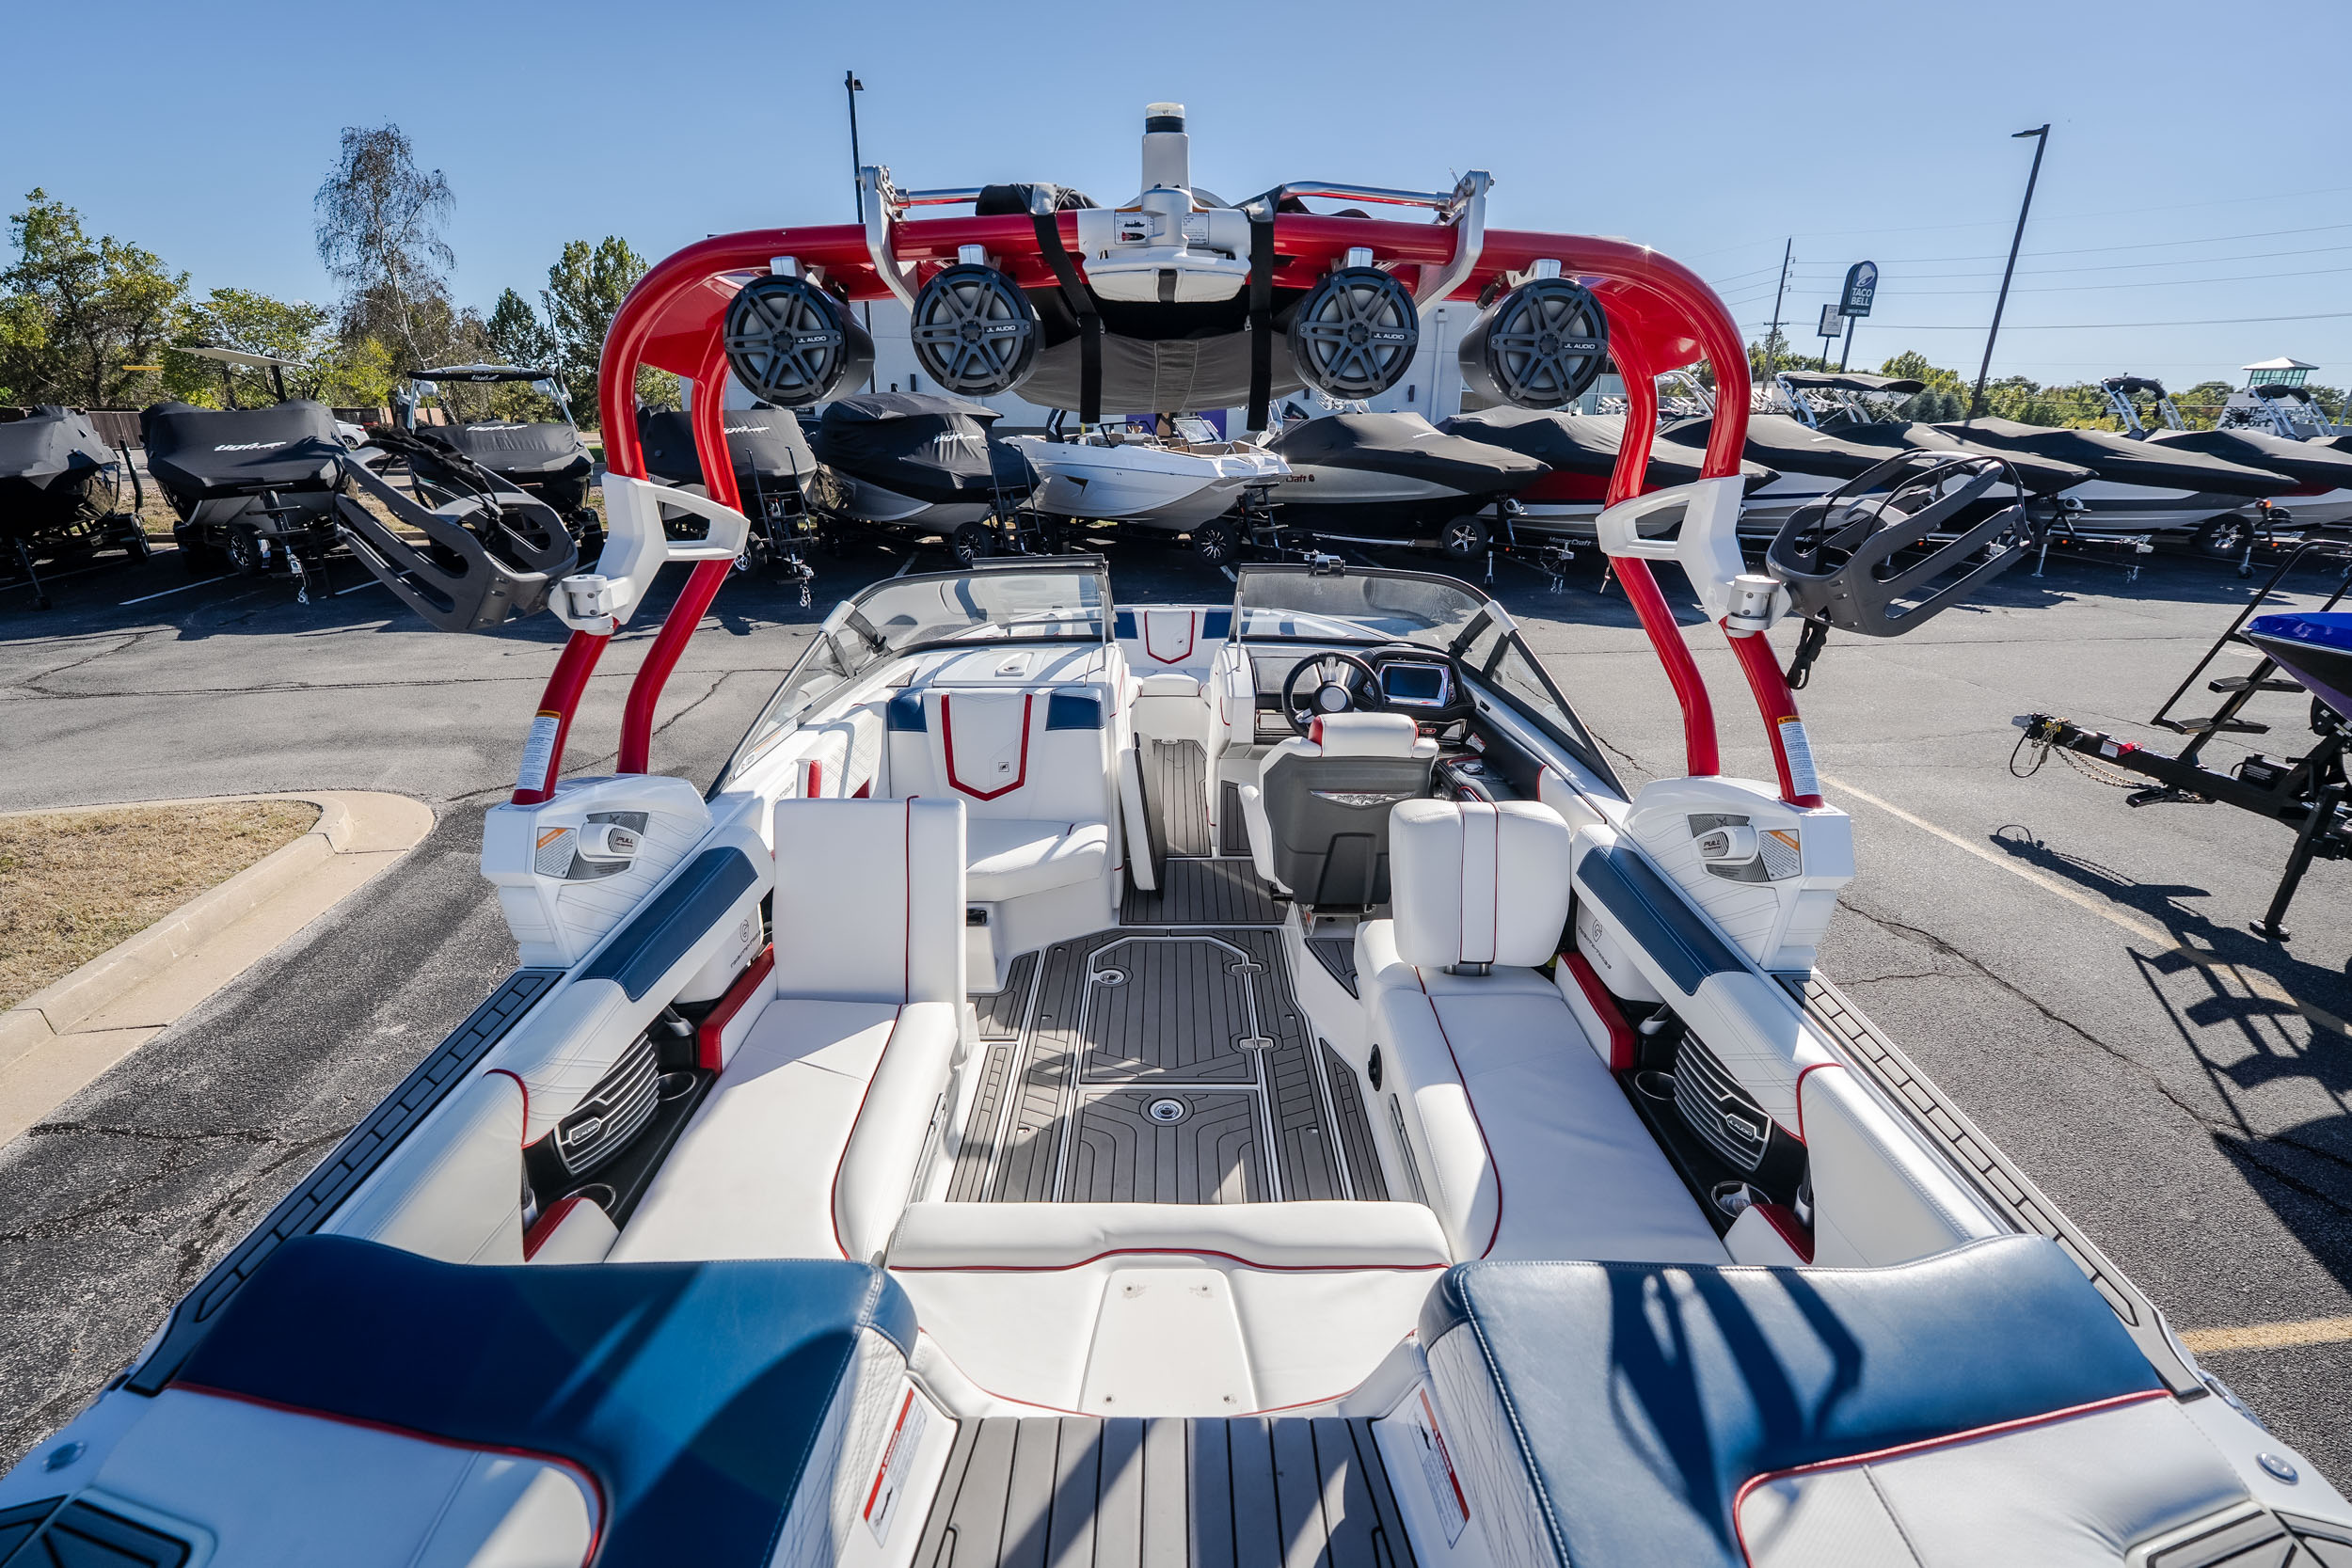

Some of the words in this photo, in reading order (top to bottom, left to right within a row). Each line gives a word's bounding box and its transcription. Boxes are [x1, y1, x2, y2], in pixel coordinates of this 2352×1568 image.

[1851, 287, 1872, 297] TACO
[1851, 296, 1870, 306] BELL
[1549, 536, 1592, 546] MasterCraft
[616, 836, 633, 845] PULL
